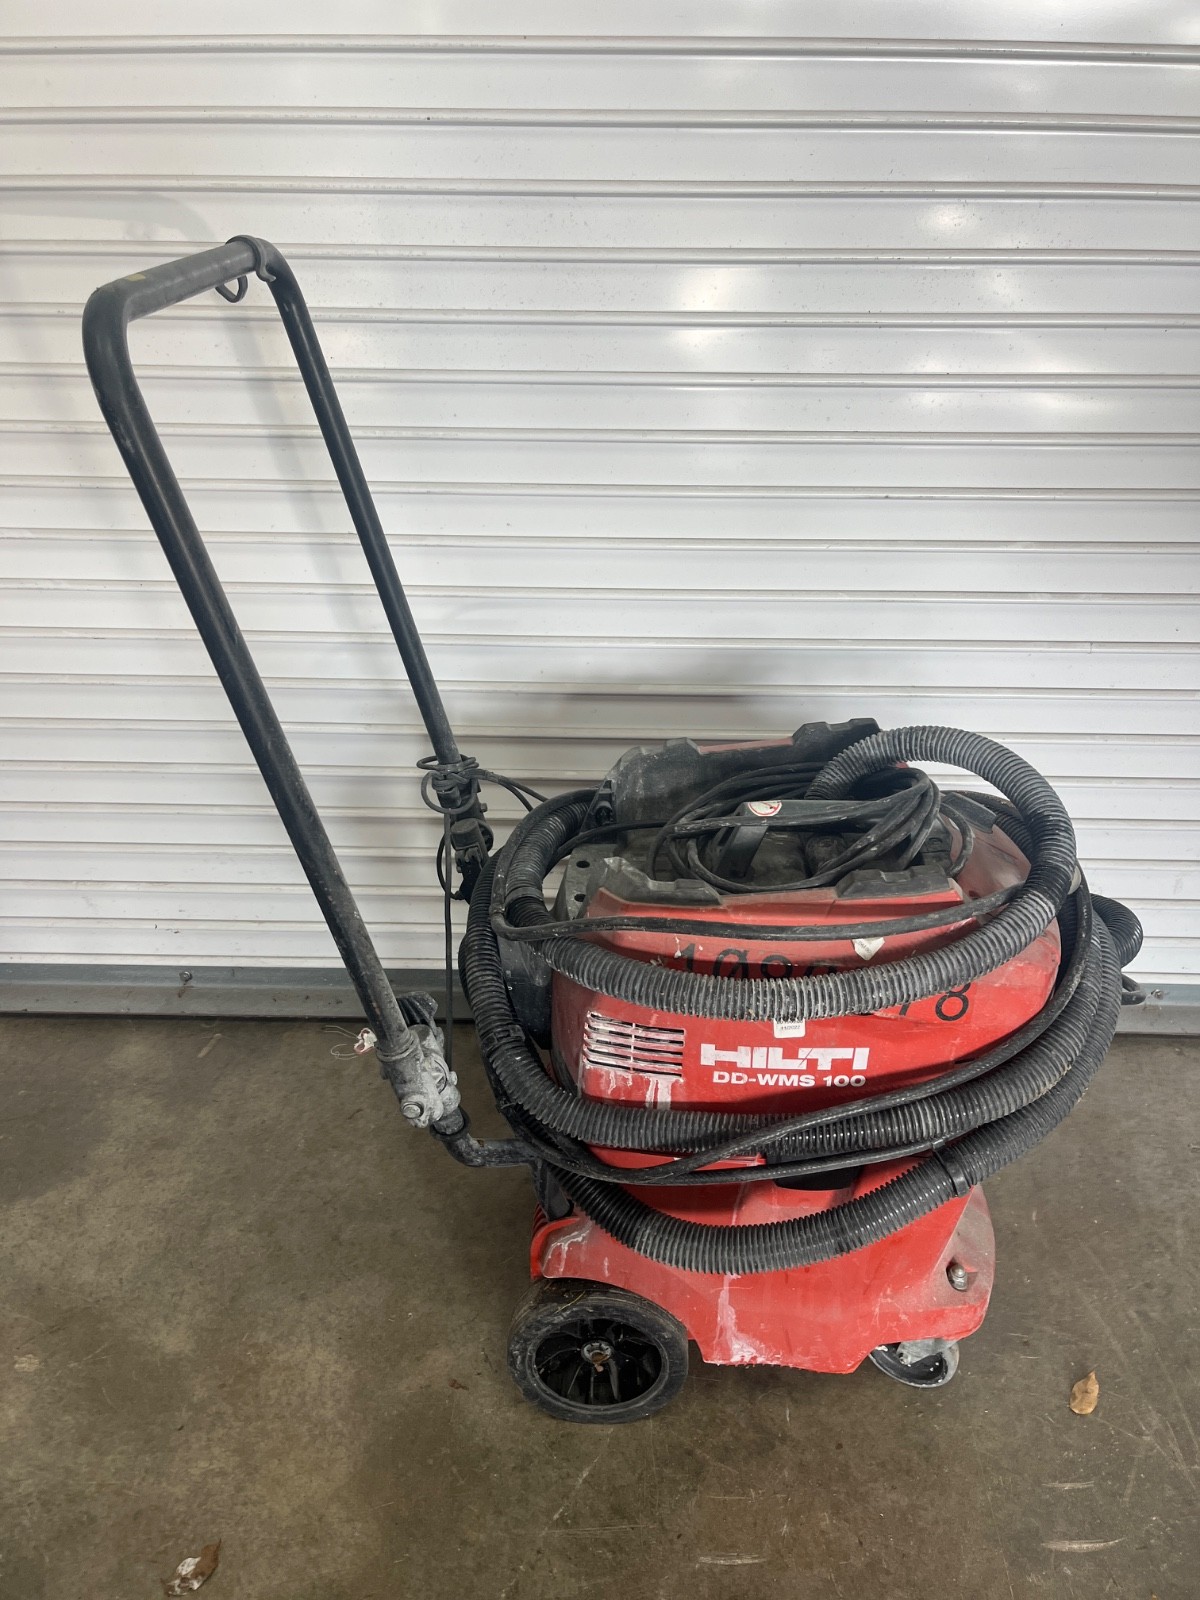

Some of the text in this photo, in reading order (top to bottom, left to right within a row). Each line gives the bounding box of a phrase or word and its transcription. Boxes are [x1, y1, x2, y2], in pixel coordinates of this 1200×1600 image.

[700, 1043, 870, 1071] HILTI
[712, 1071, 867, 1088] DD-WMS 100
